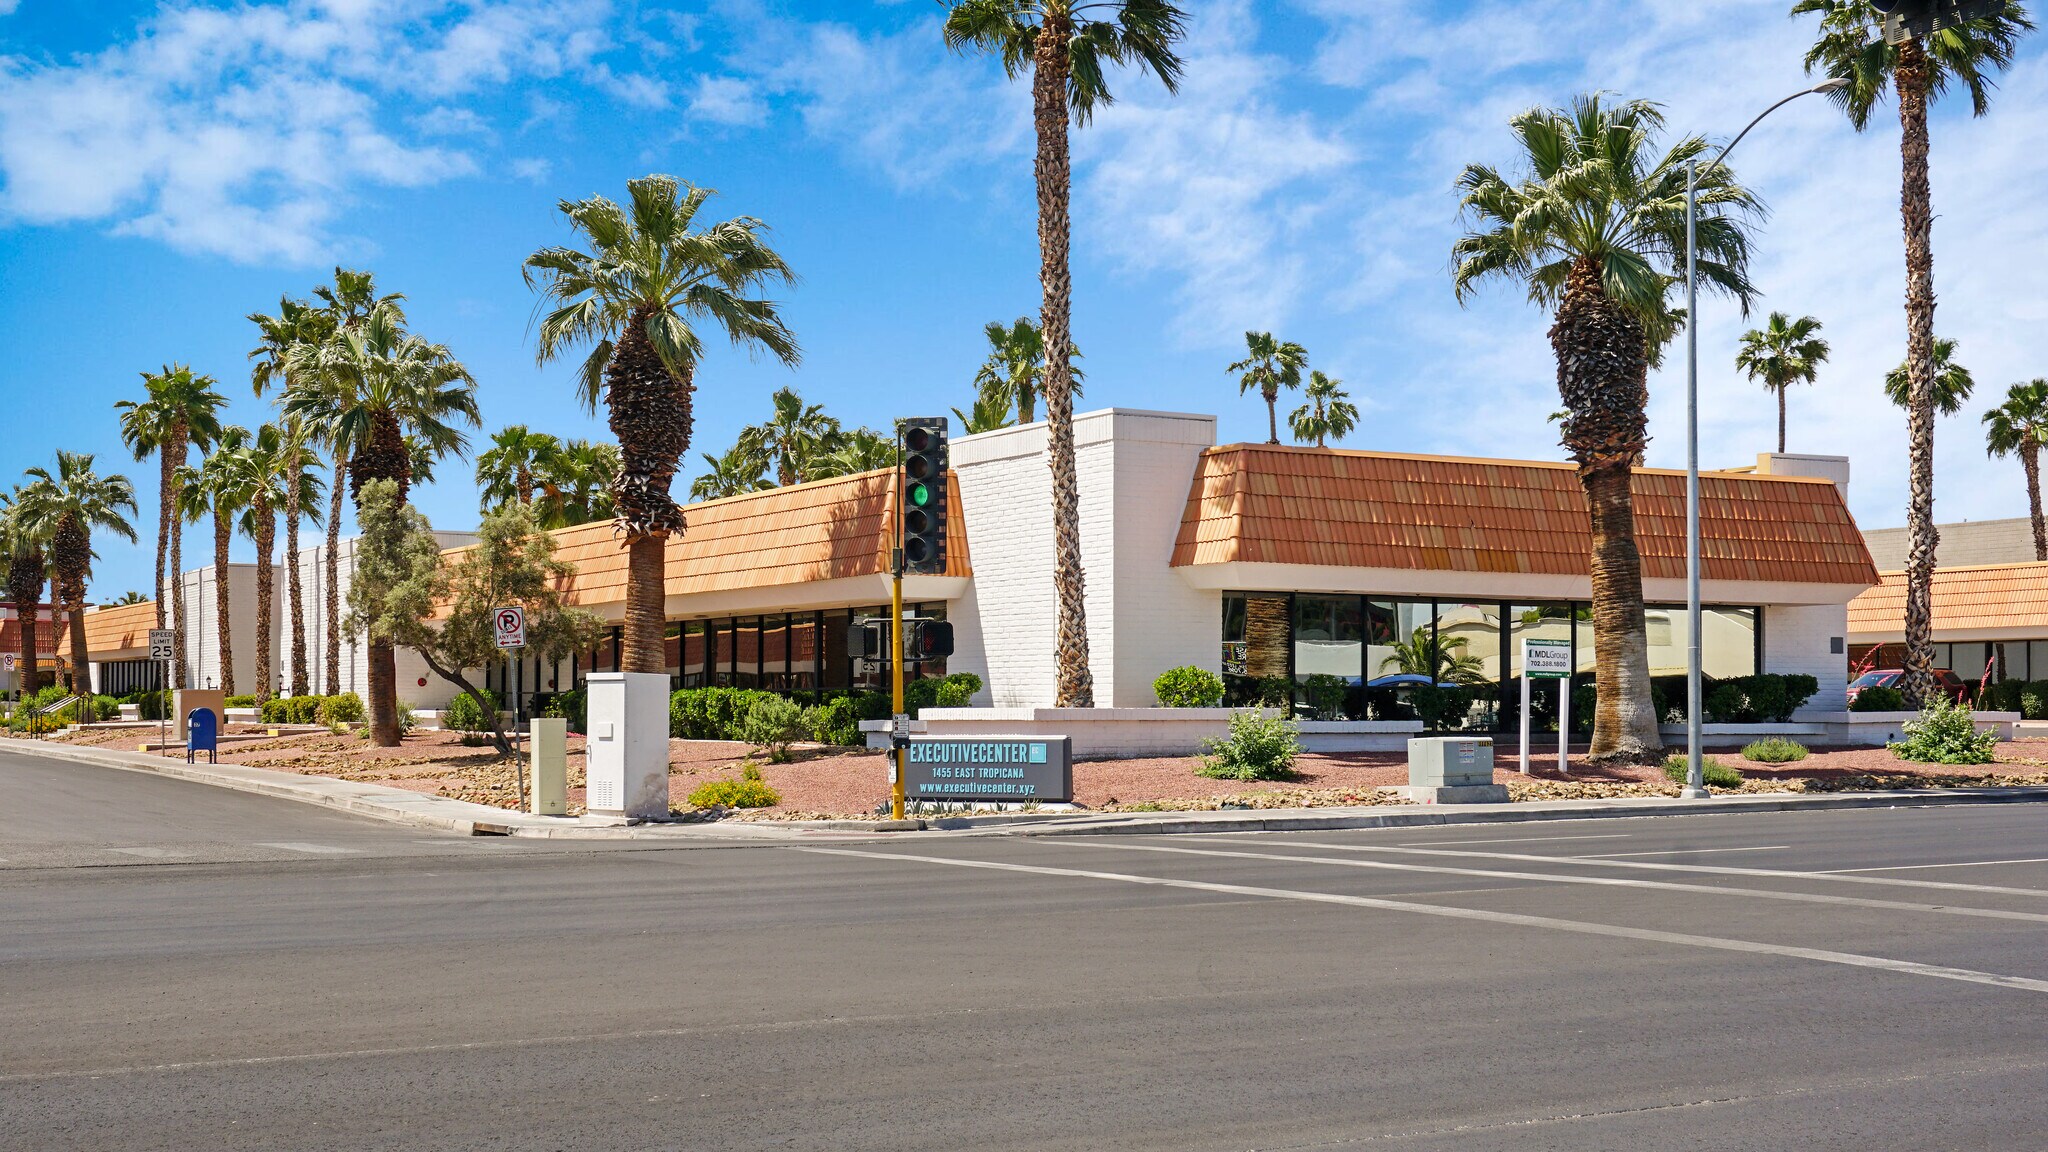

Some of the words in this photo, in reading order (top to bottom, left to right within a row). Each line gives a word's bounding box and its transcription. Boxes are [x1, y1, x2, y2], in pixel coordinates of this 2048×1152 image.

[152, 646, 172, 657] 25
[1534, 650, 1568, 660] MDLGroup
[910, 743, 1027, 763] EXECUTIVECENTER
[932, 768, 951, 777] 1455
[955, 768, 975, 778] EAST
[979, 768, 1024, 778] TROPICANA
[920, 782, 1035, 795] www.executivecenter.xyz
